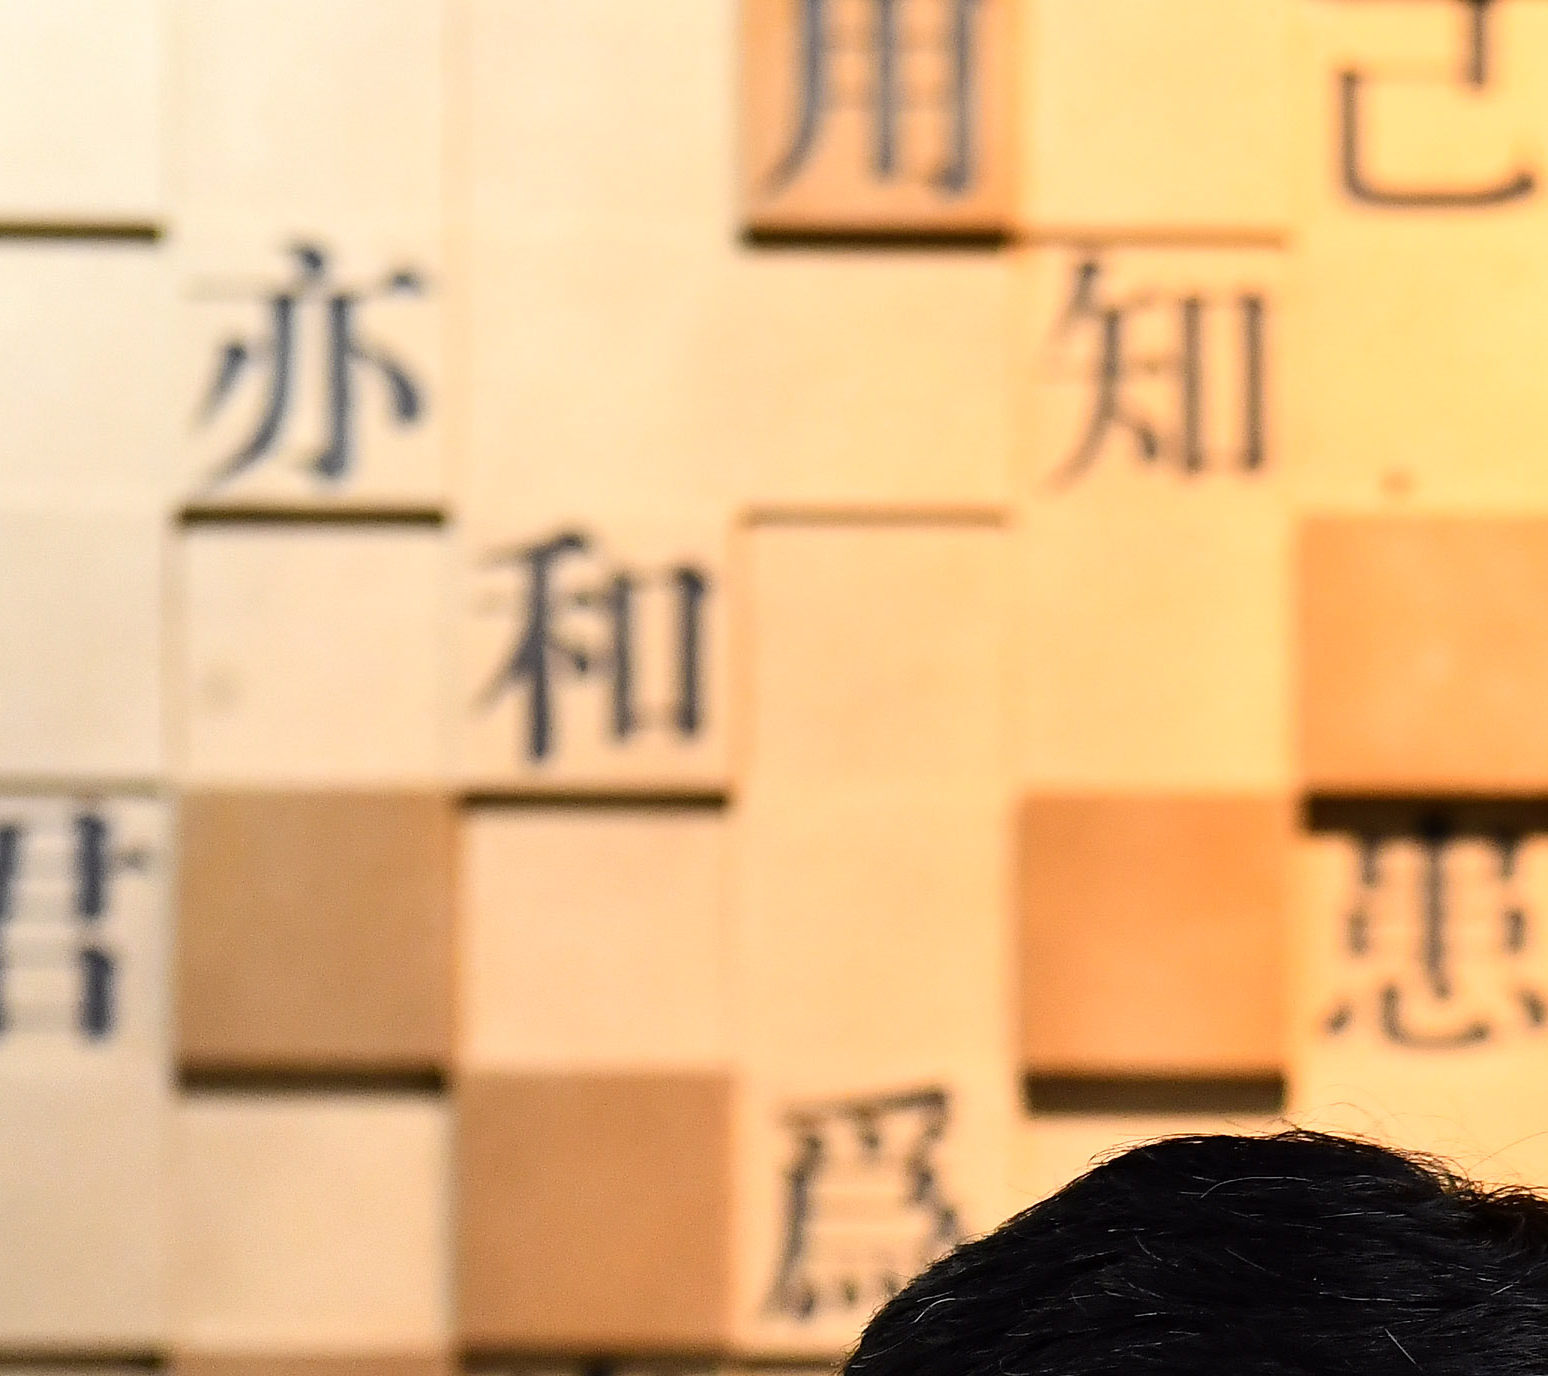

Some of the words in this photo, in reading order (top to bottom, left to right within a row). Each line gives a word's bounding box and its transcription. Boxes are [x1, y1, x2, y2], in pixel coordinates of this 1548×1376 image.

[764, 0, 980, 198] 用
[1337, 0, 1540, 208] 己
[193, 240, 427, 492] 亦
[1049, 244, 1276, 487] 知
[472, 525, 710, 767] 和
